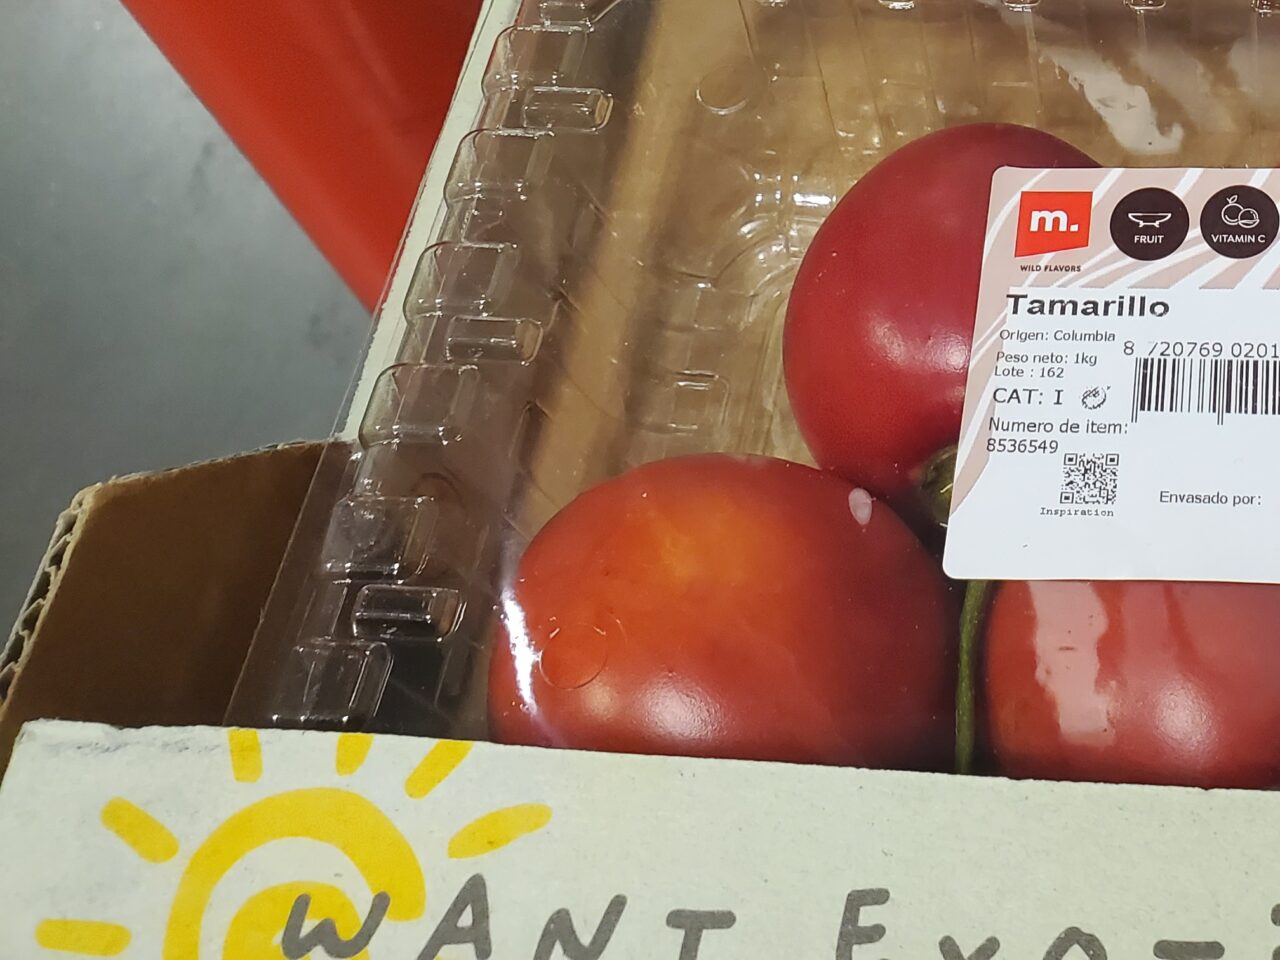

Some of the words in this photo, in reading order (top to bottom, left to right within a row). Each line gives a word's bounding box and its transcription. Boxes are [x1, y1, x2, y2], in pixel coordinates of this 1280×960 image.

[1133, 234, 1165, 245] FRUIT
[1210, 234, 1256, 244] VITAMIN
[1257, 234, 1267, 244] C
[1019, 265, 1042, 273] WILD
[1043, 265, 1082, 273] FLAVORS
[1006, 294, 1171, 319] Tamarillo
[999, 329, 1049, 343] Origen:
[1053, 329, 1116, 342] Columbia
[1123, 340, 1135, 356] 8
[996, 351, 1029, 364] Peso
[1032, 352, 1069, 365] neto:
[1074, 353, 1098, 367] 1kg
[994, 365, 1025, 378] Lote
[1039, 367, 1065, 379] 162
[992, 387, 1044, 405] CAT:
[1053, 389, 1064, 406] I
[988, 416, 1054, 434] Numero
[1059, 418, 1080, 434] de
[1085, 419, 1129, 435] item:
[986, 438, 1059, 454] 8536549
[1159, 491, 1229, 506] Envasado
[1232, 492, 1263, 508] por:
[1039, 507, 1115, 518] Inspiration
